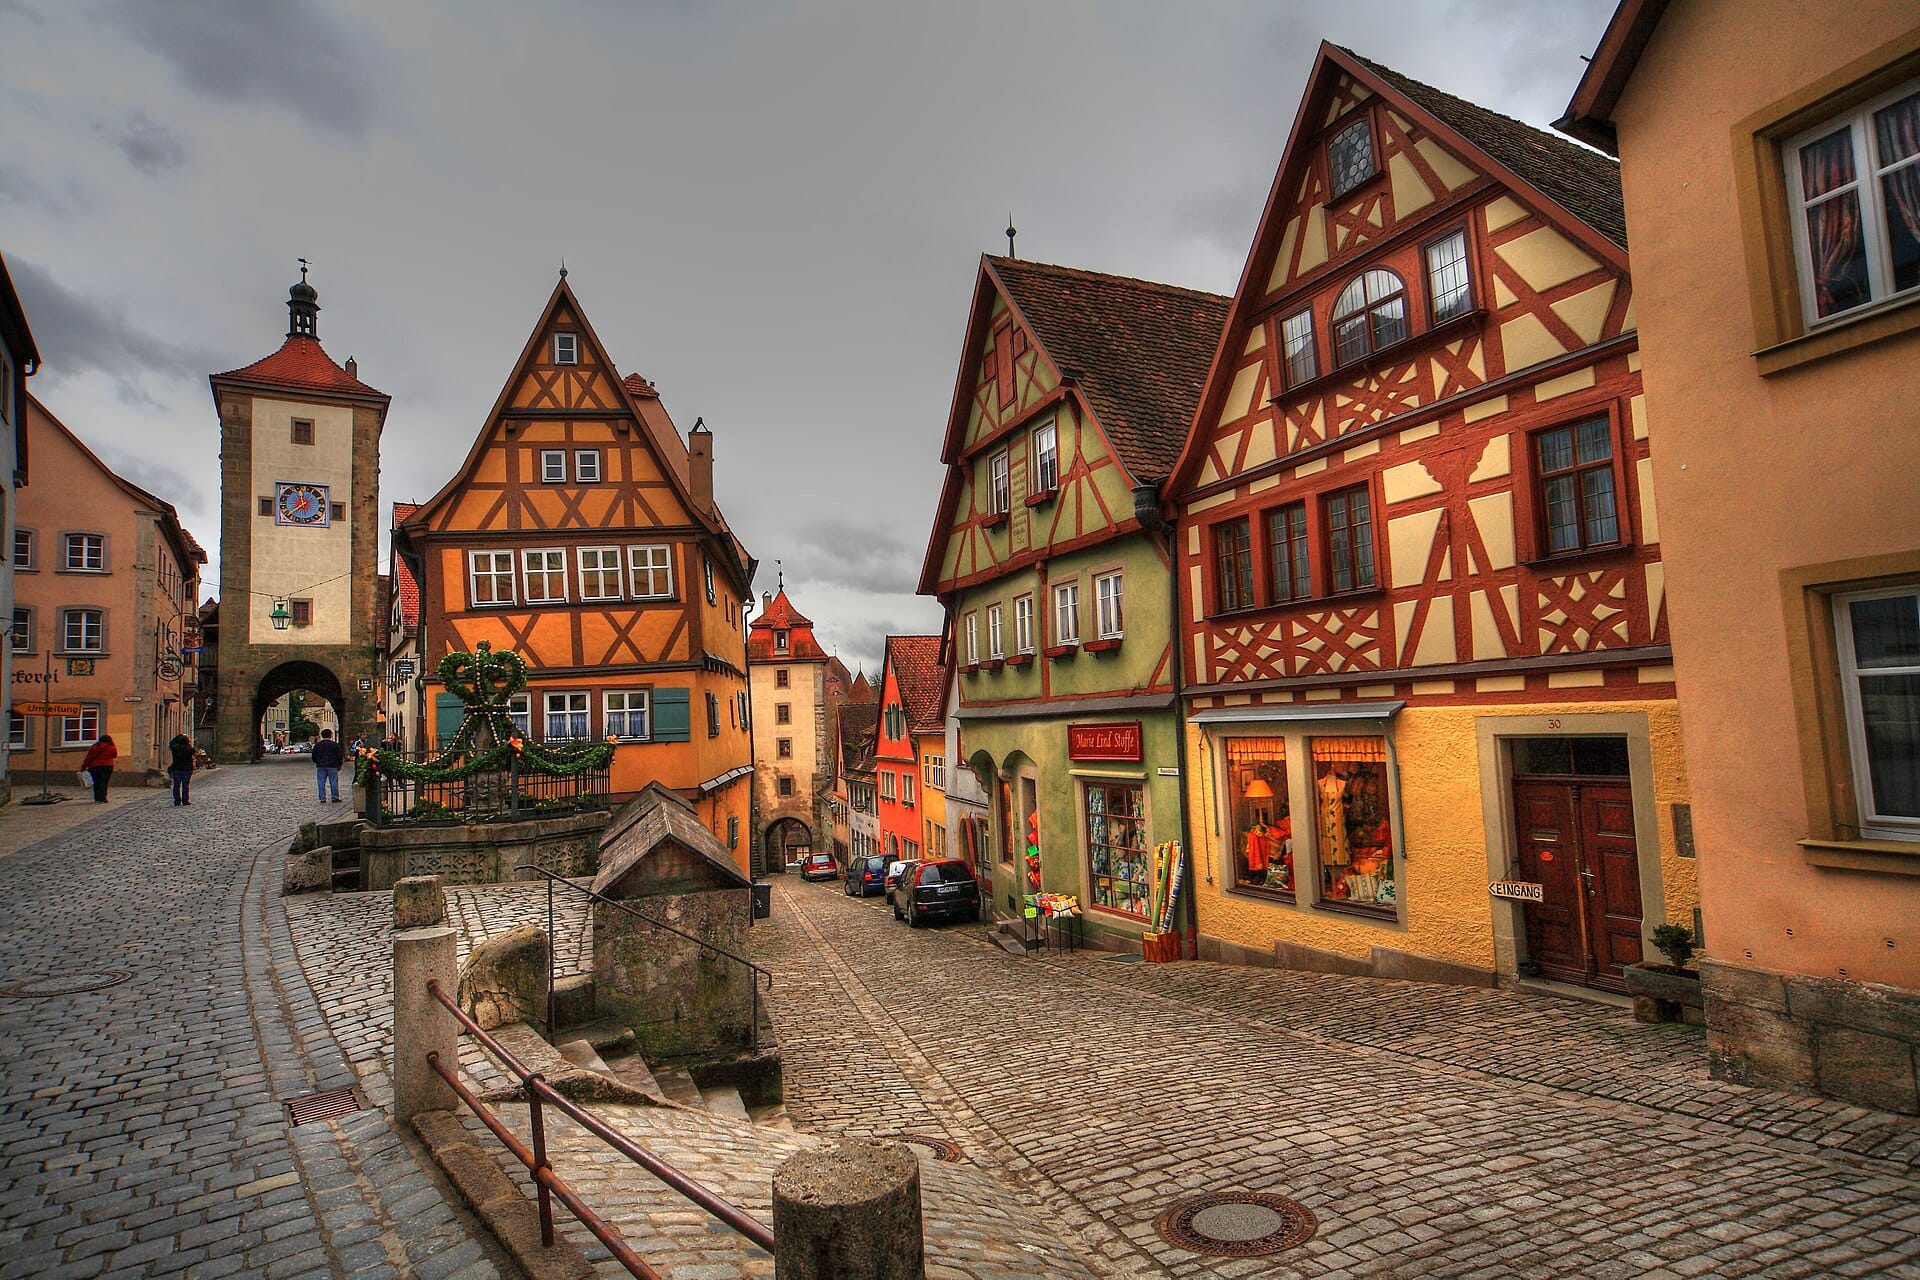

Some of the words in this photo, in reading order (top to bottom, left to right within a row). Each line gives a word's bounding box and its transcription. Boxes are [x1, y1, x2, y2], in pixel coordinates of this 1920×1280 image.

[27, 704, 79, 713] Umeitung
[1548, 719, 1561, 729] 30
[1076, 733, 1095, 748] Marie
[1096, 731, 1113, 748] Lind
[1114, 730, 1134, 753] Stoffe
[1496, 883, 1540, 899] EINGANG
